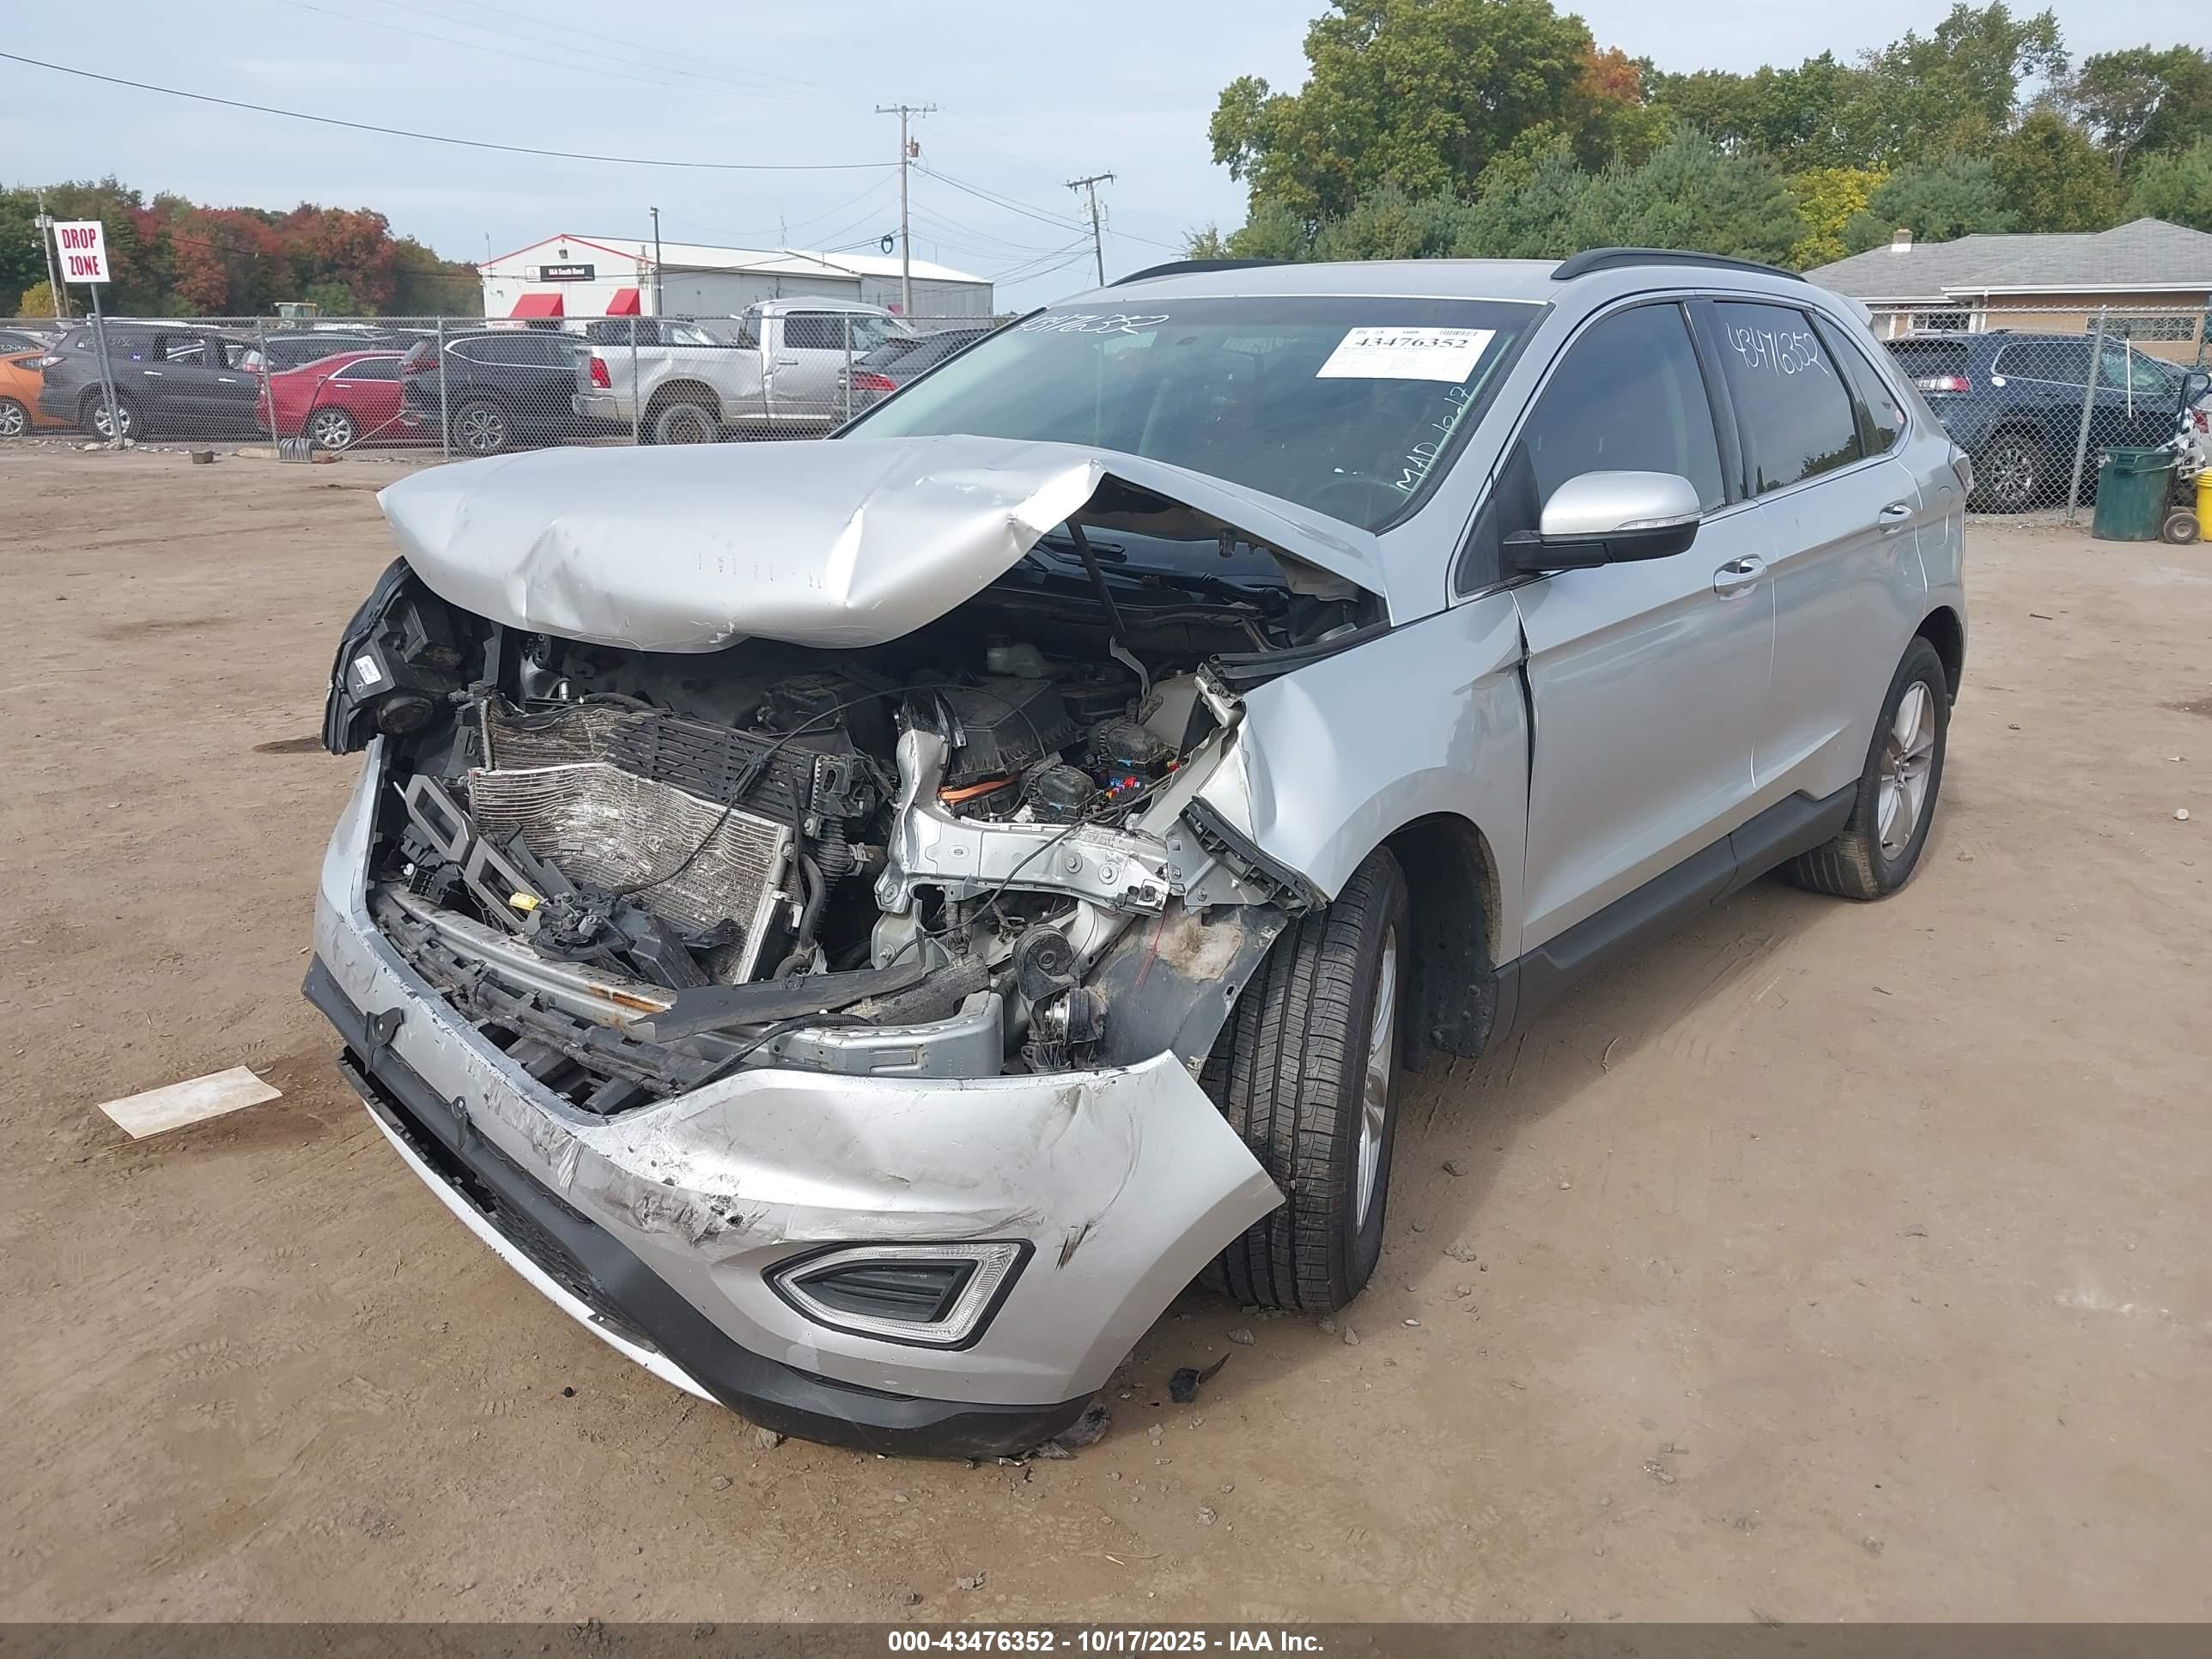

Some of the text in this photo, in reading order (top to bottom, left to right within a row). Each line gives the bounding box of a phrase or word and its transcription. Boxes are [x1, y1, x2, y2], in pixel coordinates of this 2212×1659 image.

[61, 228, 96, 249] DROP
[68, 256, 100, 276] ZONE
[1354, 337, 1469, 349] 43476352
[1726, 322, 1832, 378] 43476352
[1396, 442, 1441, 492] MAD
